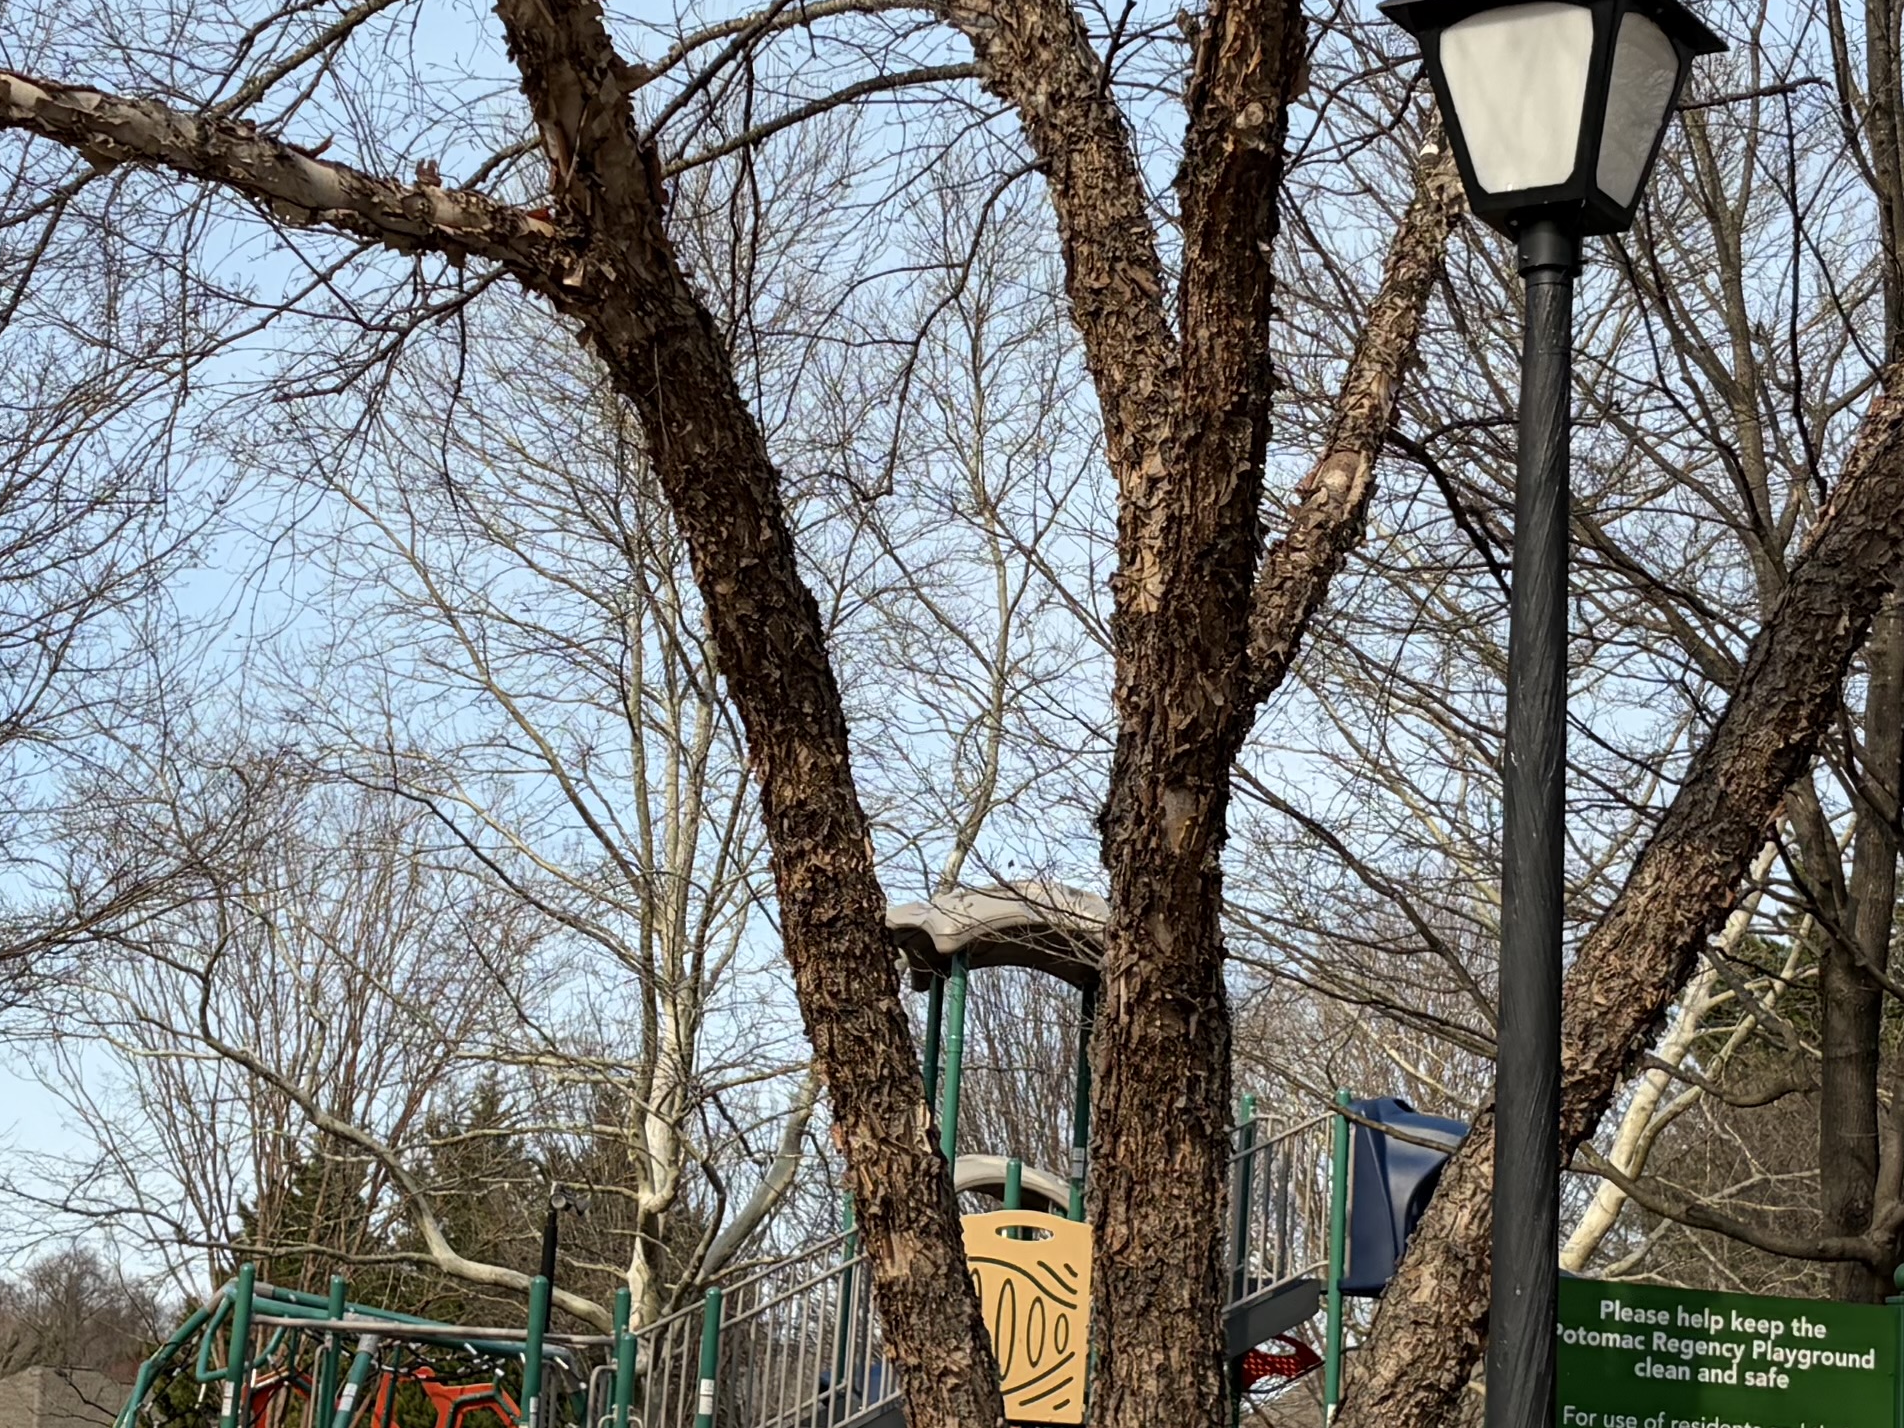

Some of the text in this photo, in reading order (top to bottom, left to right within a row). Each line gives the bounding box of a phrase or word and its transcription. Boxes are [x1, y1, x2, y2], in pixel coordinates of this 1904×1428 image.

[1600, 1300, 1826, 1340] Please help keep the
[1652, 1332, 1745, 1364] Regency
[1752, 1340, 1875, 1370] Playground
[1634, 1356, 1790, 1388] clean and safe
[1564, 1405, 1597, 1426] For
